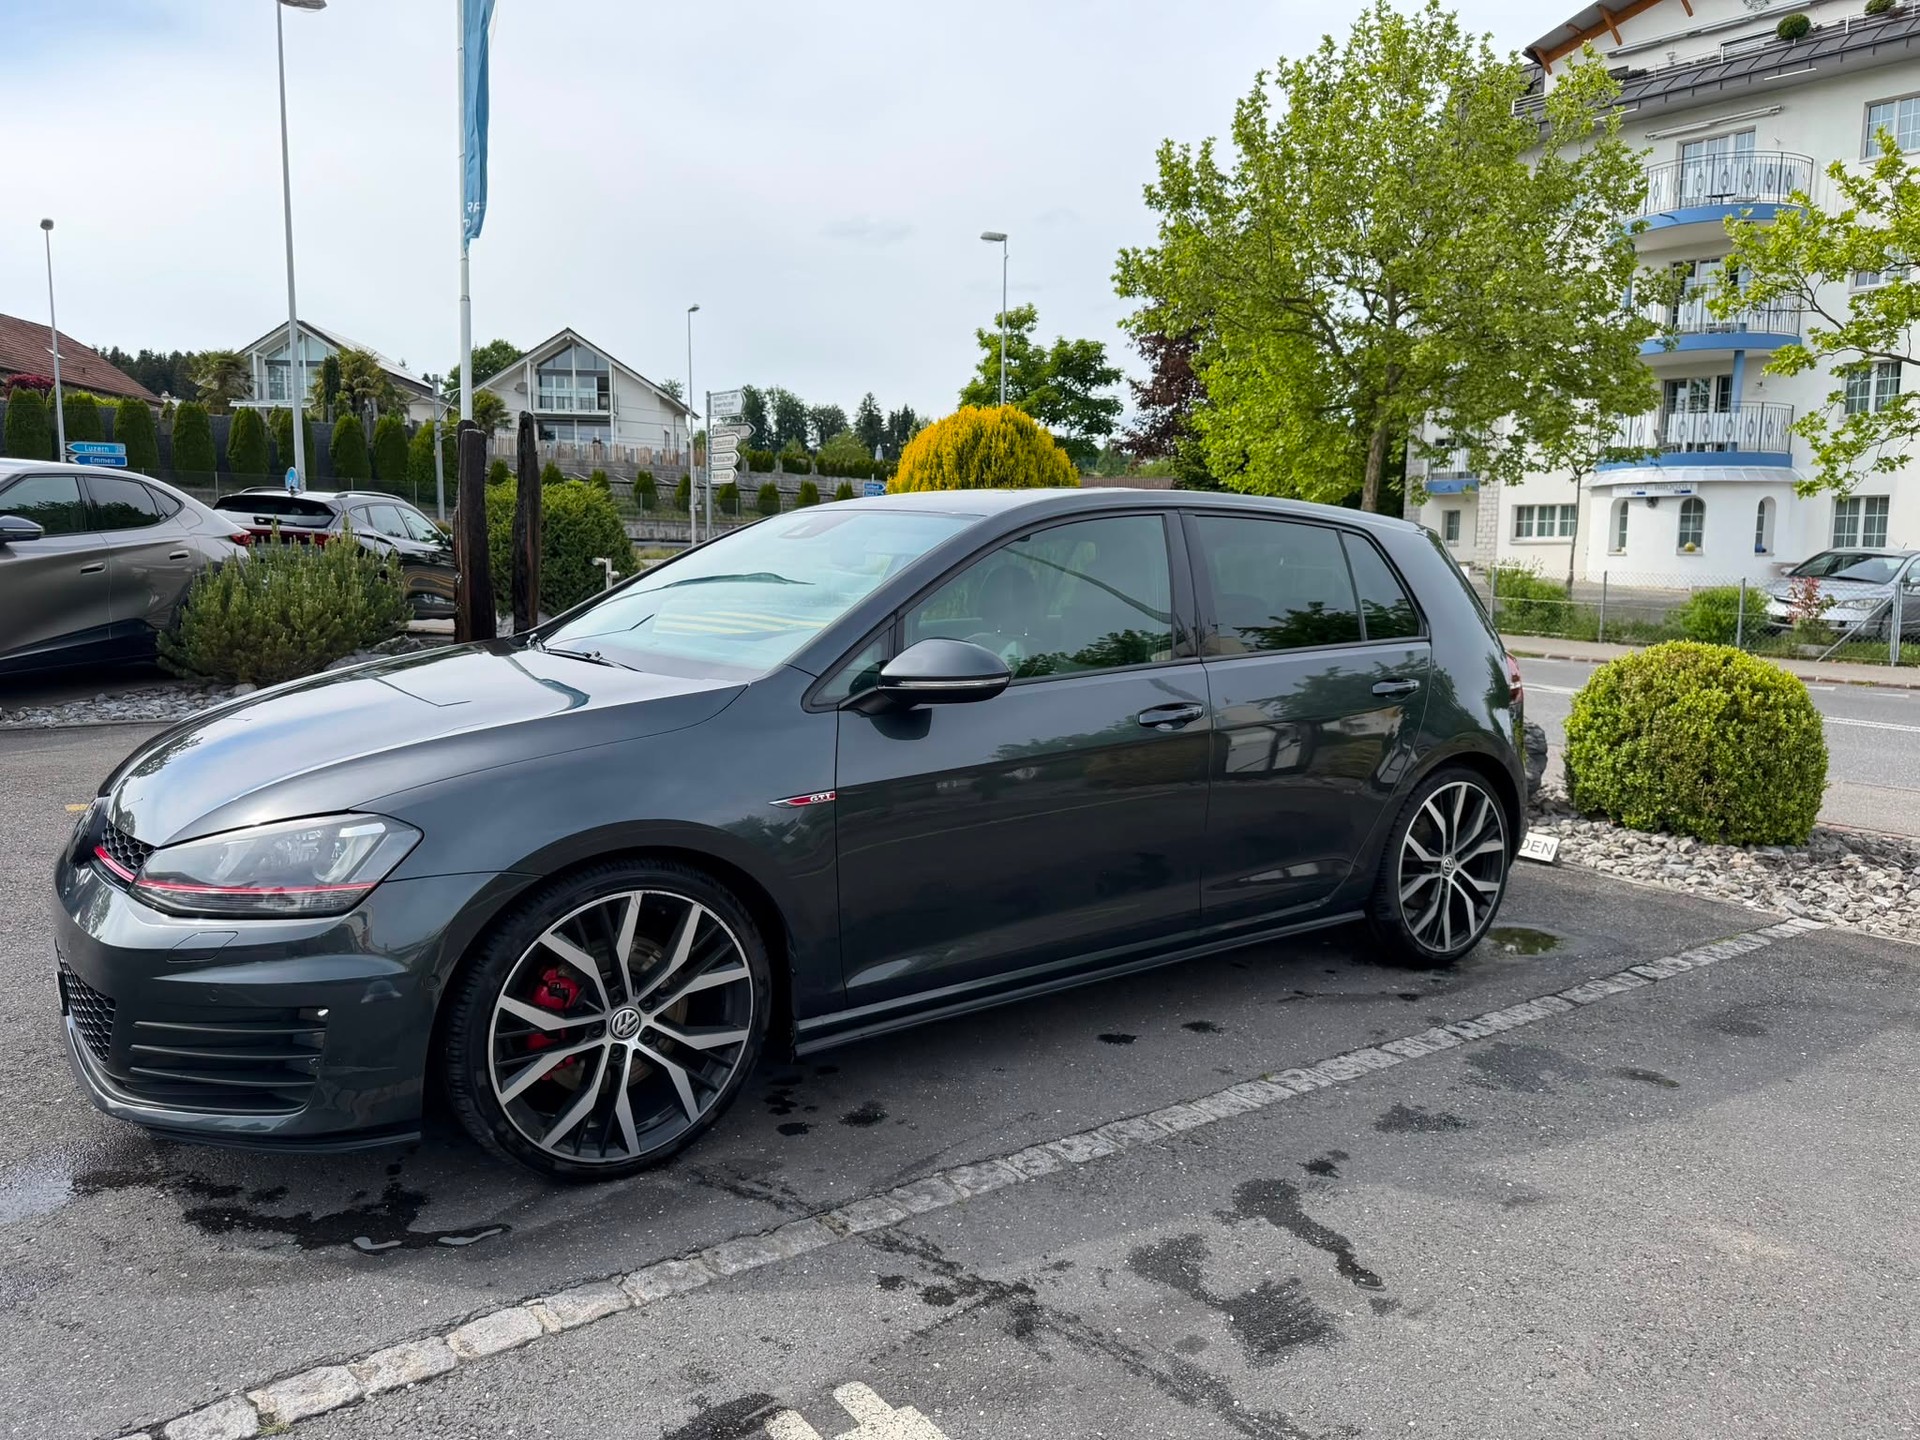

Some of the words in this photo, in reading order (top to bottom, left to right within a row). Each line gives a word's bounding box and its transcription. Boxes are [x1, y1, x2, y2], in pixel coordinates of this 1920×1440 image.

[84, 444, 110, 453] Luzern
[90, 456, 116, 464] Emmen
[810, 792, 831, 802] GTI
[612, 1009, 640, 1038] VW
